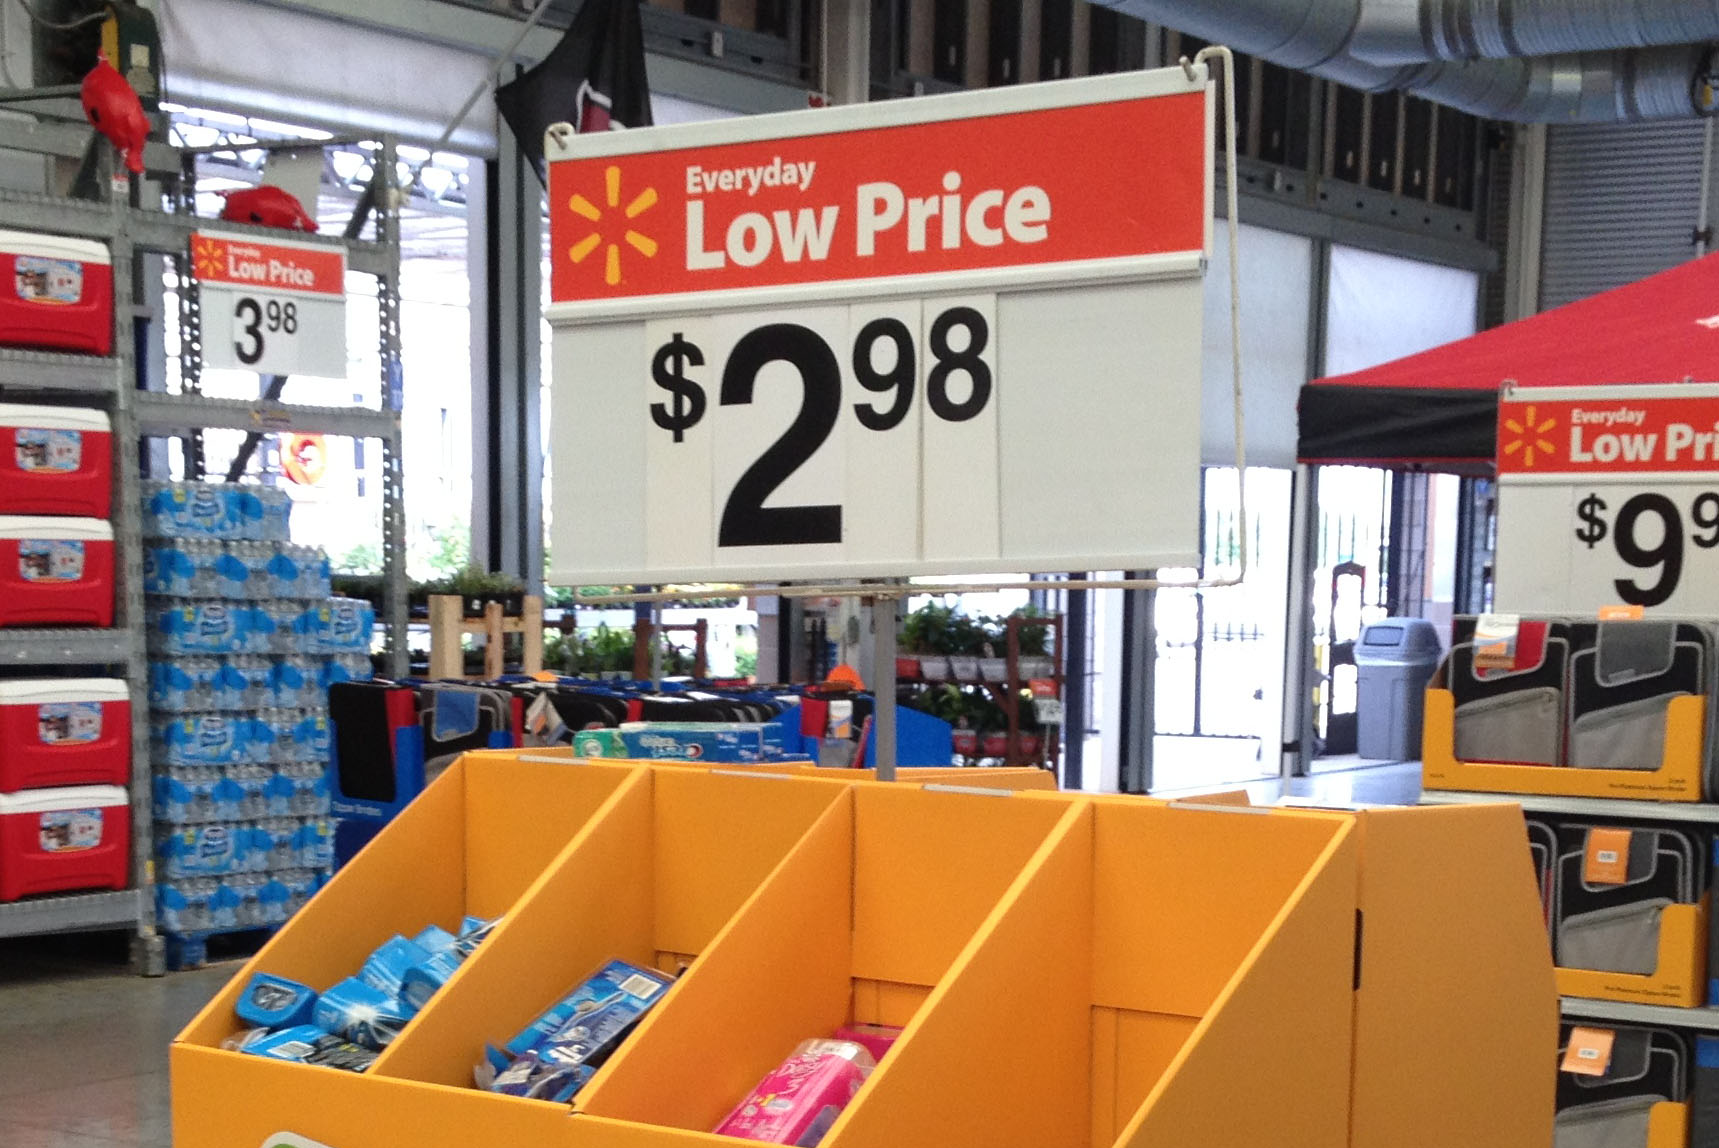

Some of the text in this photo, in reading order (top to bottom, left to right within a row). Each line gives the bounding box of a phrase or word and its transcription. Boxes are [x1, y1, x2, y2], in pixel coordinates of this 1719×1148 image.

[686, 157, 816, 195] Everyday
[685, 170, 1052, 272] Low Price
[227, 255, 315, 286] Low Price
[1570, 407, 1646, 427] Everyday
[1569, 426, 1658, 463] Low
